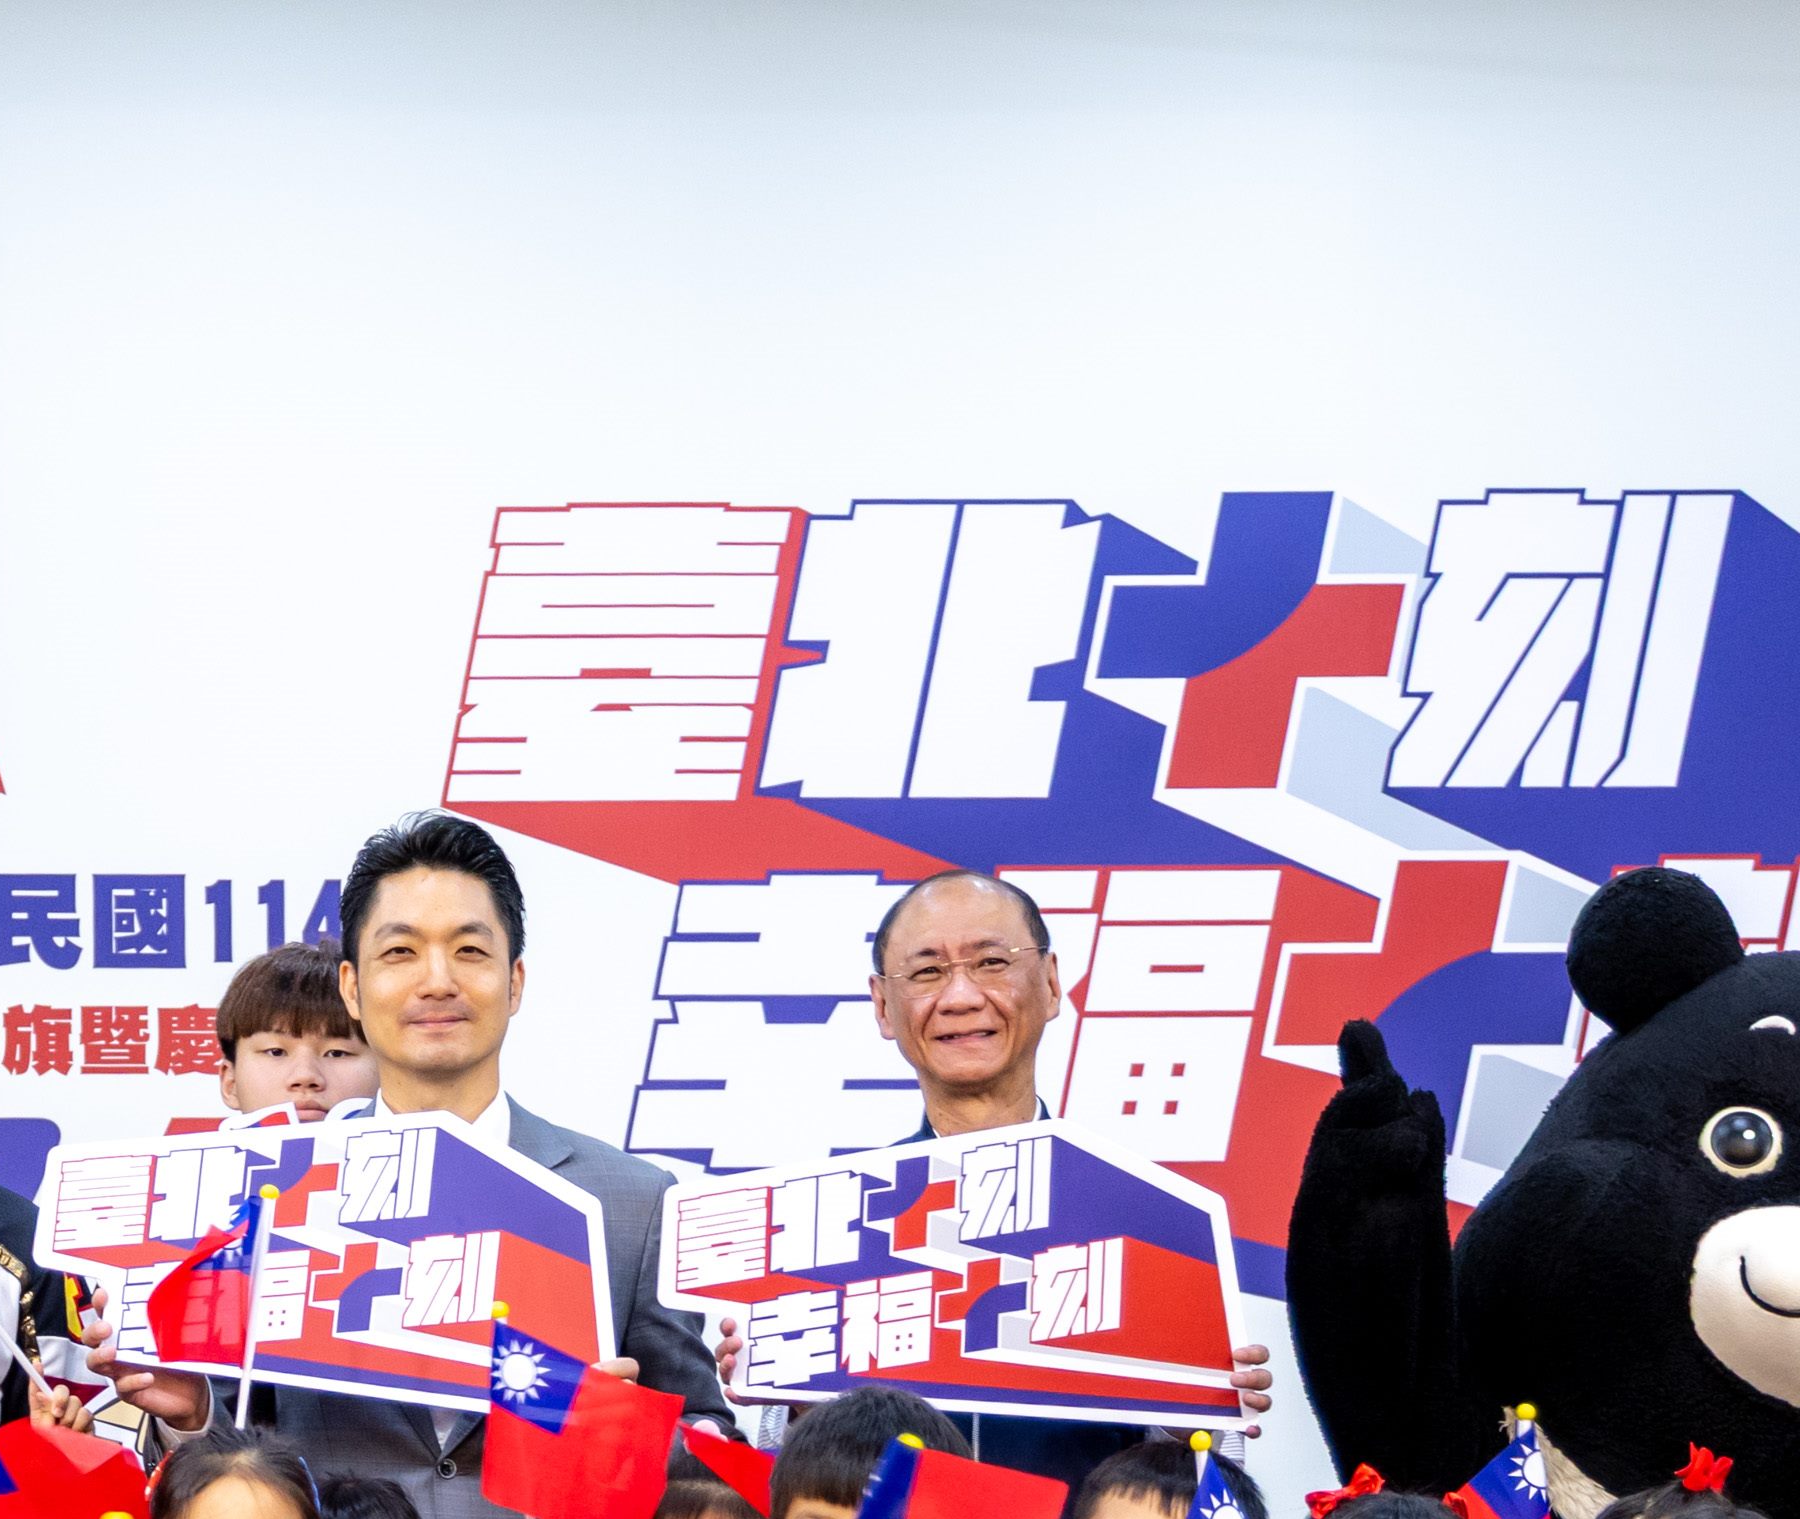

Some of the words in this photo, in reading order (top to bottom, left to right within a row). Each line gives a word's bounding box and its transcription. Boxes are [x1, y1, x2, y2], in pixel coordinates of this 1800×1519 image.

[676, 1135, 1054, 1292] 臺北十刻
[747, 1236, 1125, 1387] 幸福十刻
